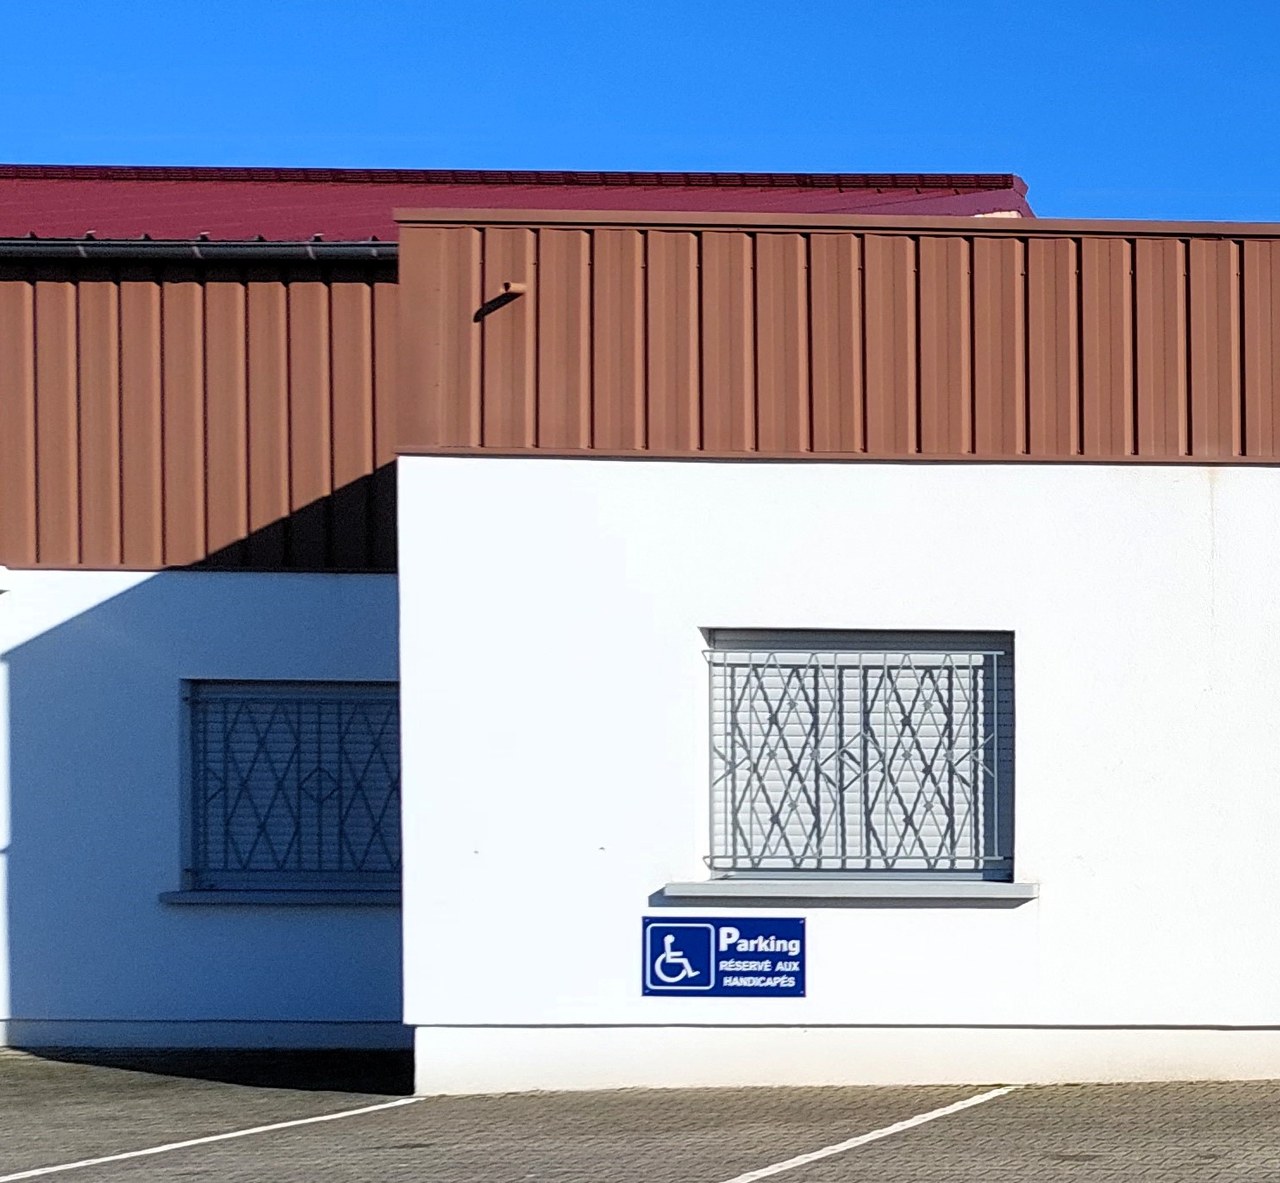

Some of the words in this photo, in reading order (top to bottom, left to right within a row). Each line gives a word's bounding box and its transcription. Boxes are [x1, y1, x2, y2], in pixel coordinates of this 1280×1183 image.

[719, 927, 801, 956] Parking
[719, 958, 773, 972] RÉSERVÉ
[775, 960, 801, 972] AUX
[722, 974, 797, 989] HANDICAPÉS
